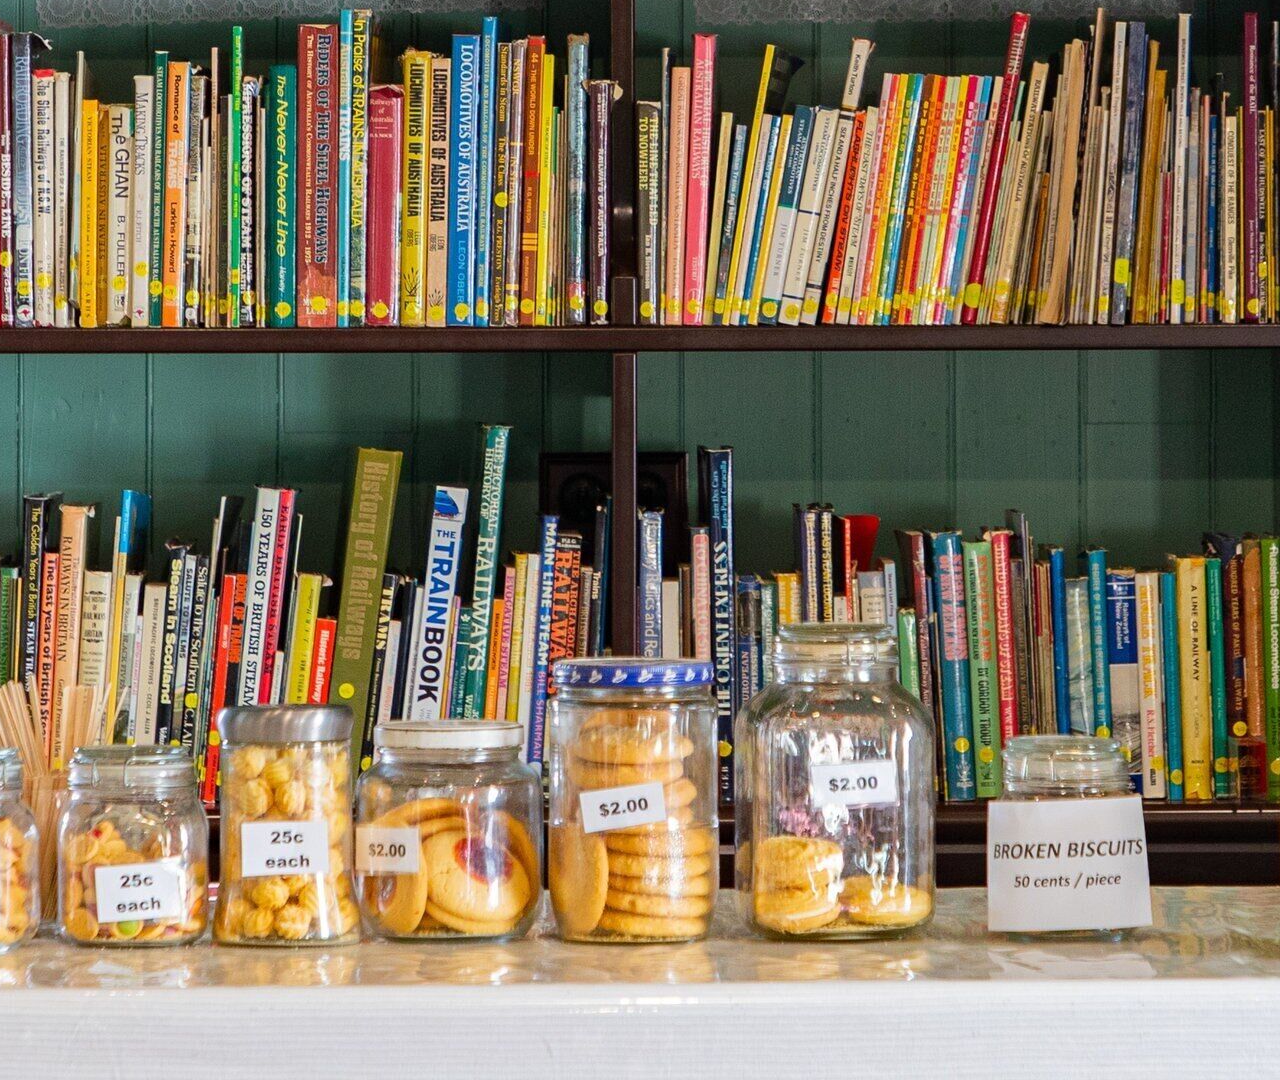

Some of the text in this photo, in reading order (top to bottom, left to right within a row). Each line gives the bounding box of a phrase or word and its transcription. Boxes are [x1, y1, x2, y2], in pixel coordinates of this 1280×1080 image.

[315, 35, 330, 263] RIDERS OF THE STEEL HIGHWAYS
[457, 44, 473, 231] LOCOMOTIVES OF AUSTRALIA
[250, 508, 273, 656] 150 YEARS OF BRITISH
[339, 461, 388, 659] History of Railways
[538, 522, 557, 665] MAIN LINE STEAM
[57, 536, 73, 661] RAILWAYS IN BRITAIN
[160, 558, 182, 703] Steam in Scotland
[468, 537, 496, 670] RAILWAYS
[714, 541, 730, 716] THE ORIENT EXPRESS
[598, 796, 649, 818] $2.00
[829, 774, 878, 792] $2.00
[265, 853, 310, 870] each
[269, 829, 304, 846] 25c
[368, 842, 406, 859] $2.00
[993, 838, 1143, 860] BROKEN BISCUITS
[115, 895, 162, 913] each
[120, 873, 154, 889] 25c
[1013, 873, 1030, 888] 50
[1034, 874, 1070, 889] cents
[1086, 872, 1121, 891] piece
